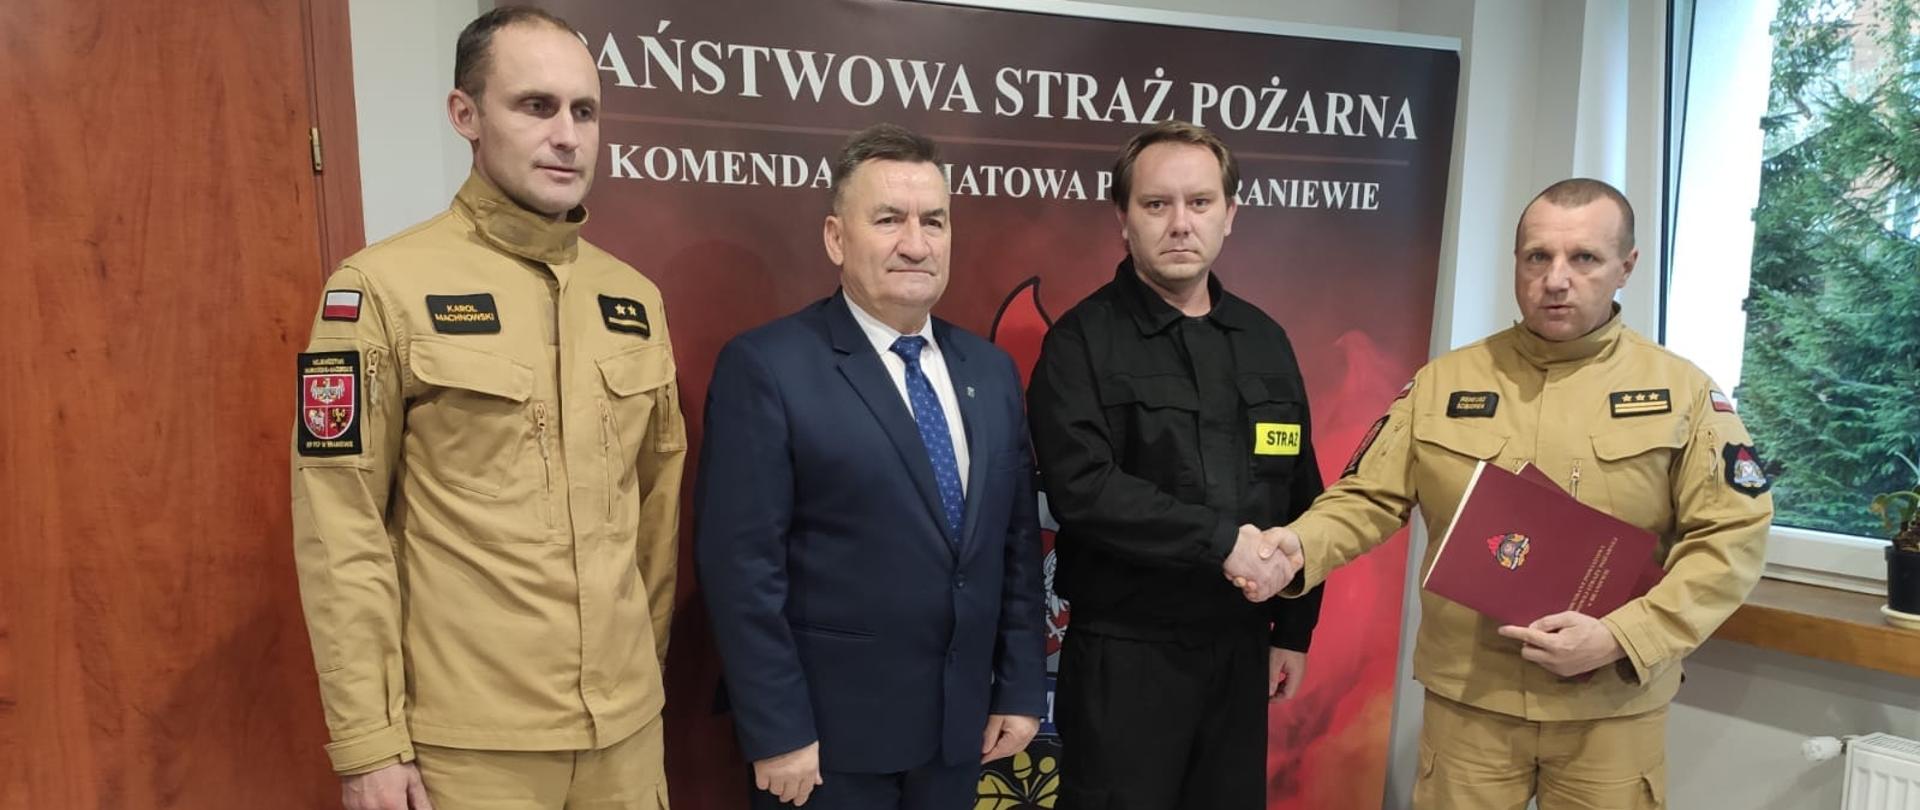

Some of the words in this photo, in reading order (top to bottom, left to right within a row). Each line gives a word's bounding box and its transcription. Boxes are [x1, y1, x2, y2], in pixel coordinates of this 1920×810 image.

[576, 20, 982, 114] AŃSTWOWA
[995, 67, 1174, 125] STRAŻ
[1189, 76, 1418, 140] POŻARNA
[608, 144, 832, 189] KOMENDA
[944, 163, 1088, 200] IATOWA
[447, 304, 477, 313] KAROL
